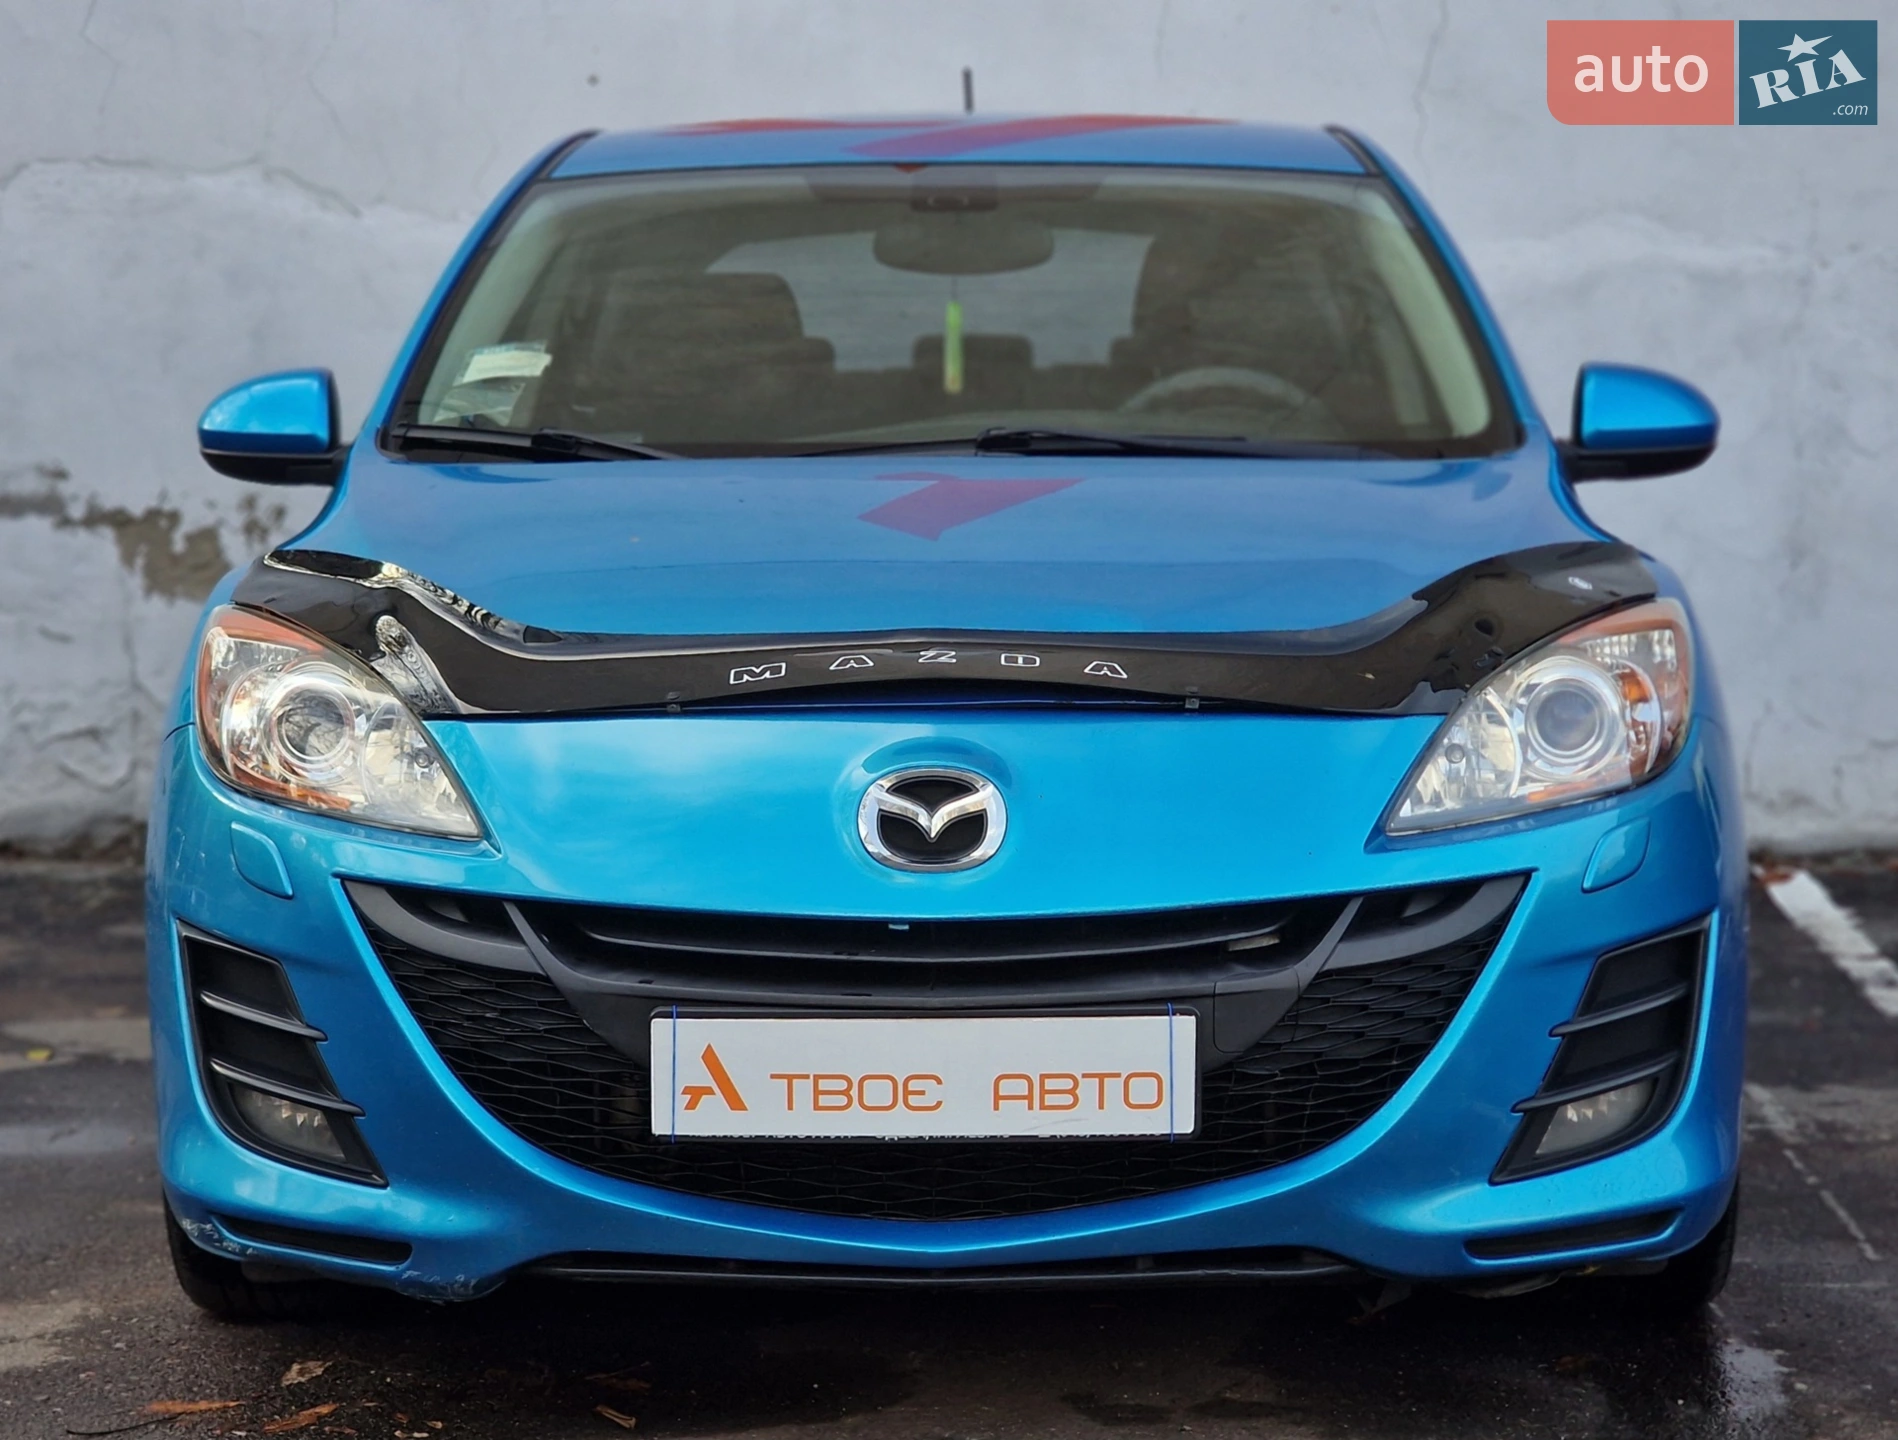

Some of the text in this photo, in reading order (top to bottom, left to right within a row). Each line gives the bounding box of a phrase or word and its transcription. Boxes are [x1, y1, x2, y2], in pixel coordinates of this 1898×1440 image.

[729, 650, 1128, 685] MAZDA
[770, 1073, 943, 1112] ТВОЄ
[993, 1072, 1164, 1111] АВТО
